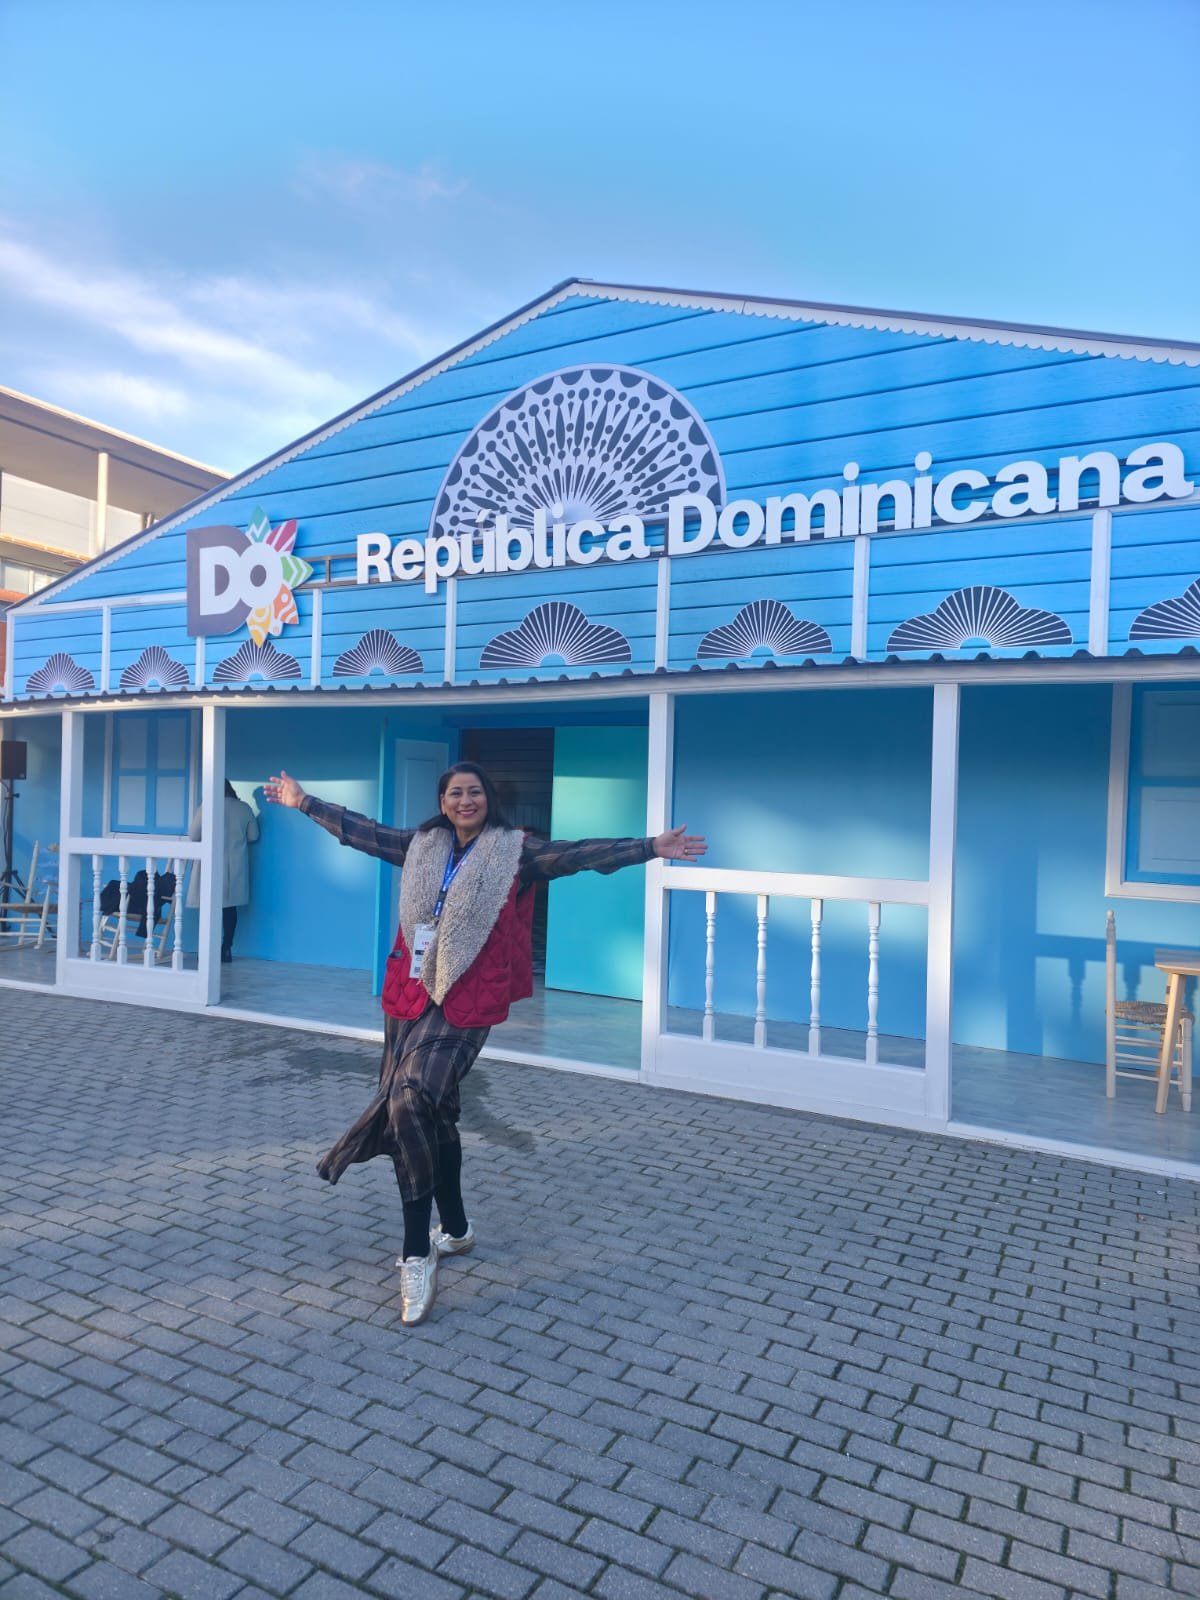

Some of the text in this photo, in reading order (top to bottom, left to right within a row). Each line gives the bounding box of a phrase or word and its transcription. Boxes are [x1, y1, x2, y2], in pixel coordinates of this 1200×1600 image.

[356, 442, 1195, 594] República Dominicana
[199, 542, 284, 616] DO
